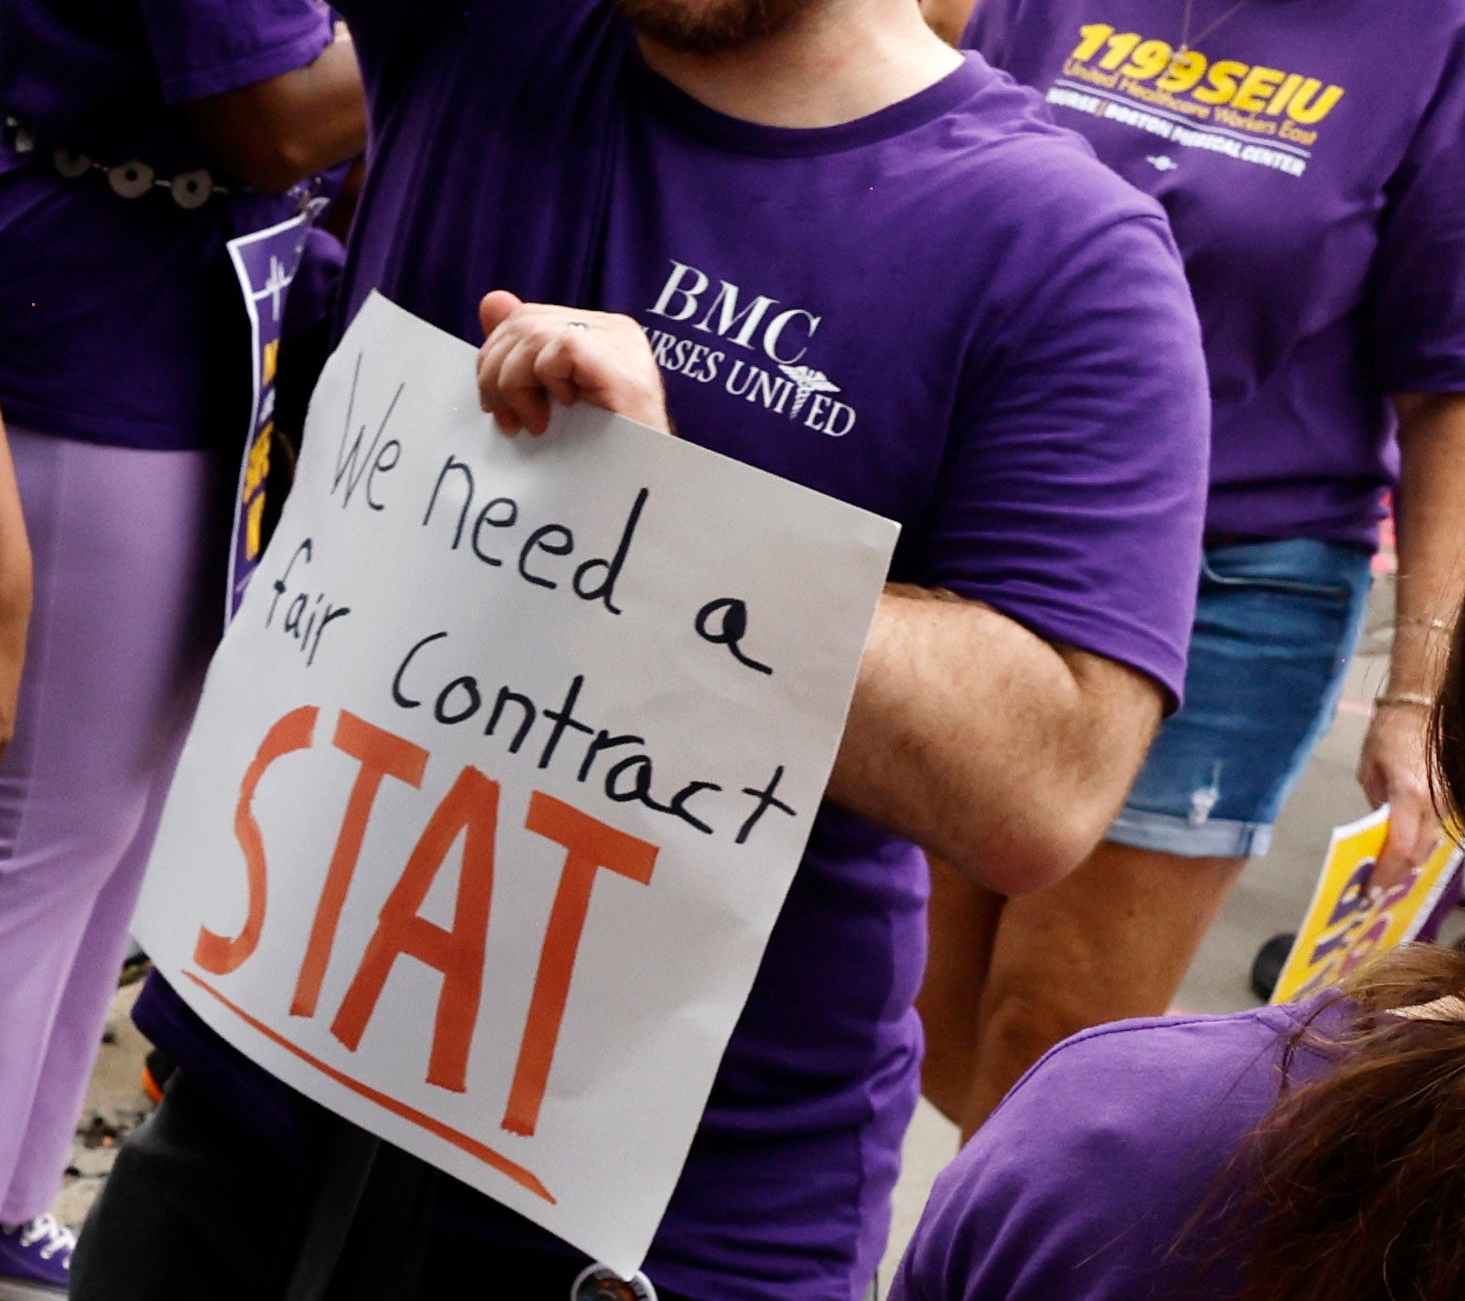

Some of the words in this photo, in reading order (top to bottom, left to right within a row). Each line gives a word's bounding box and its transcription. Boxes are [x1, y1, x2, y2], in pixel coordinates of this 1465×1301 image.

[1072, 22, 1346, 125] 1199SEIU
[645, 258, 822, 366] BMC
[331, 350, 404, 510] We
[421, 454, 649, 617] need
[692, 588, 775, 675] a
[264, 536, 352, 667] fair
[191, 704, 660, 1137] STAT
